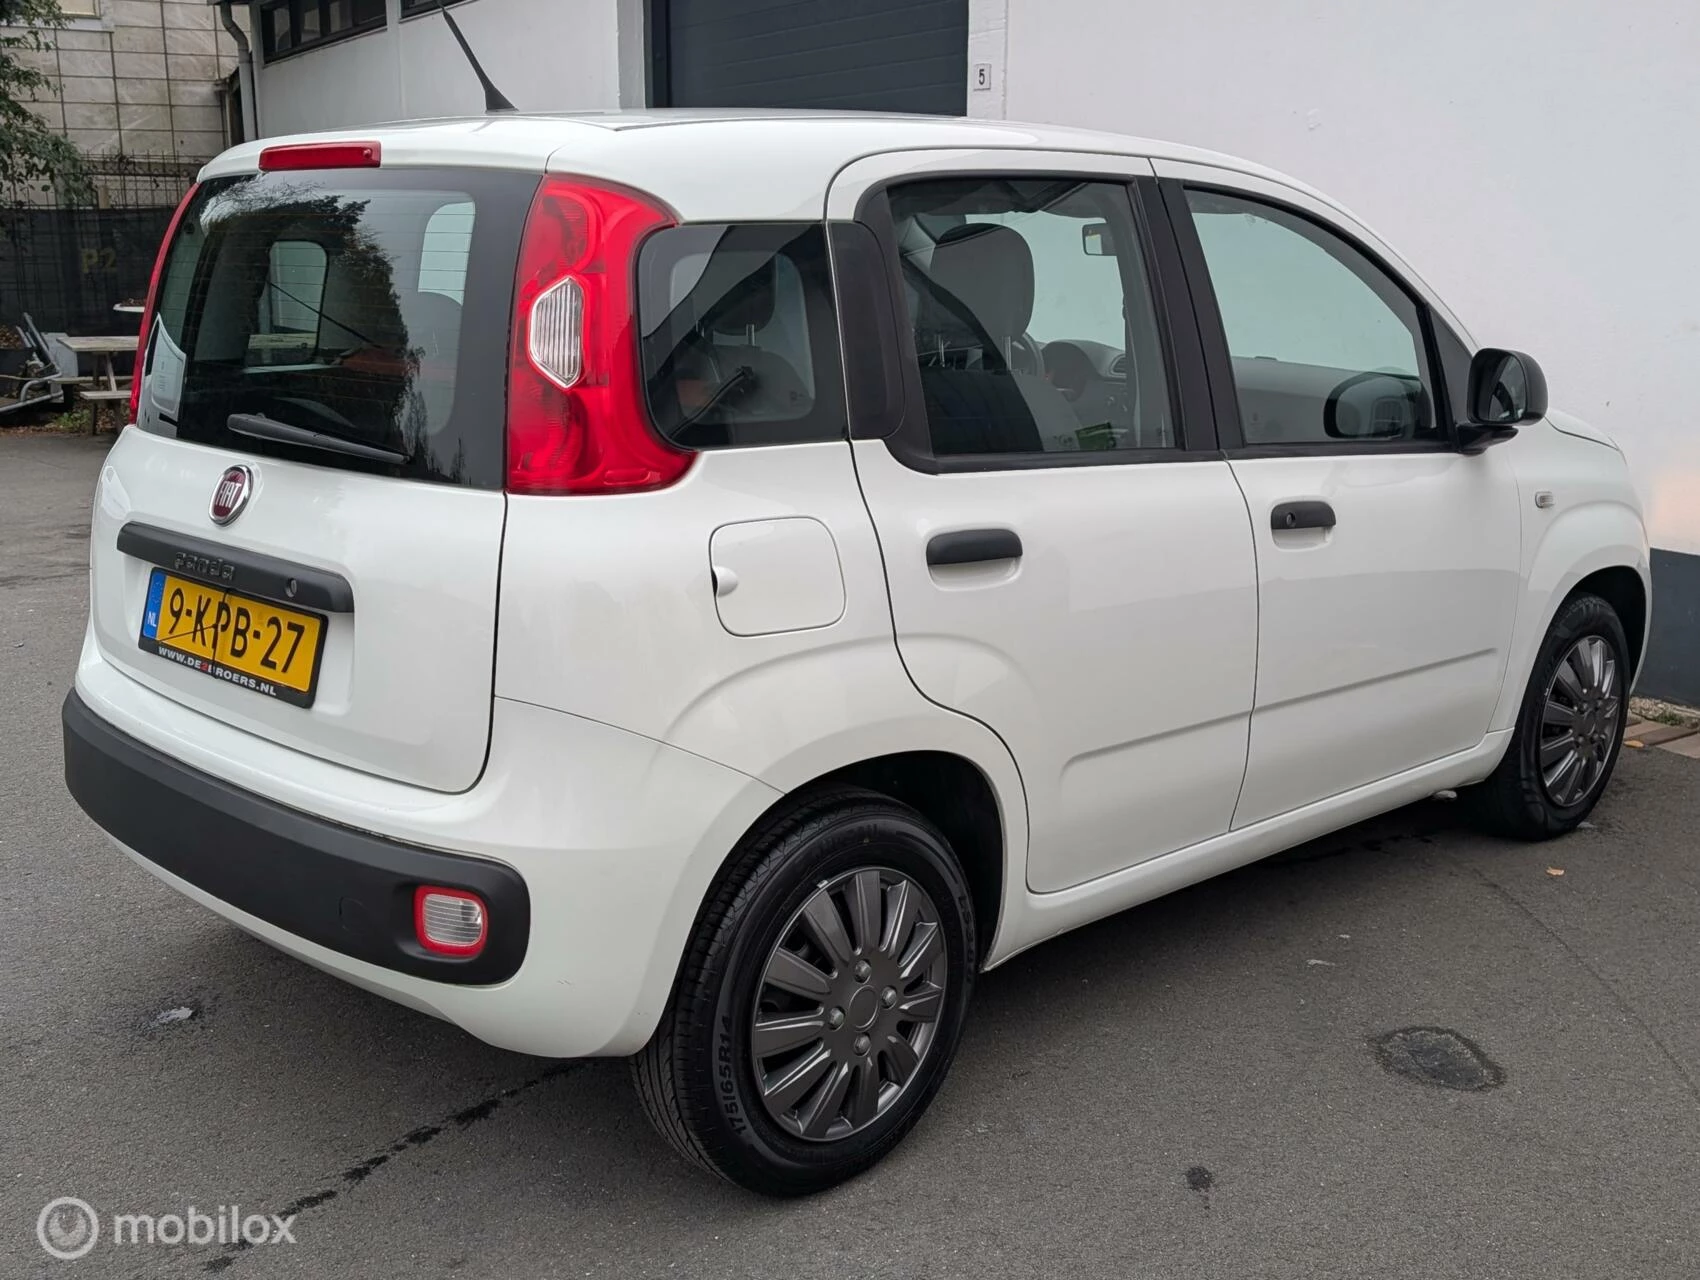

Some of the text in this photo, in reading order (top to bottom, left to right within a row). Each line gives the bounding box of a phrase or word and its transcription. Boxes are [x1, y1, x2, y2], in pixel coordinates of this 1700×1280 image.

[978, 68, 986, 86] 5
[215, 480, 242, 508] FIAT
[147, 610, 157, 628] NL
[168, 587, 306, 674] 9-KPB-27
